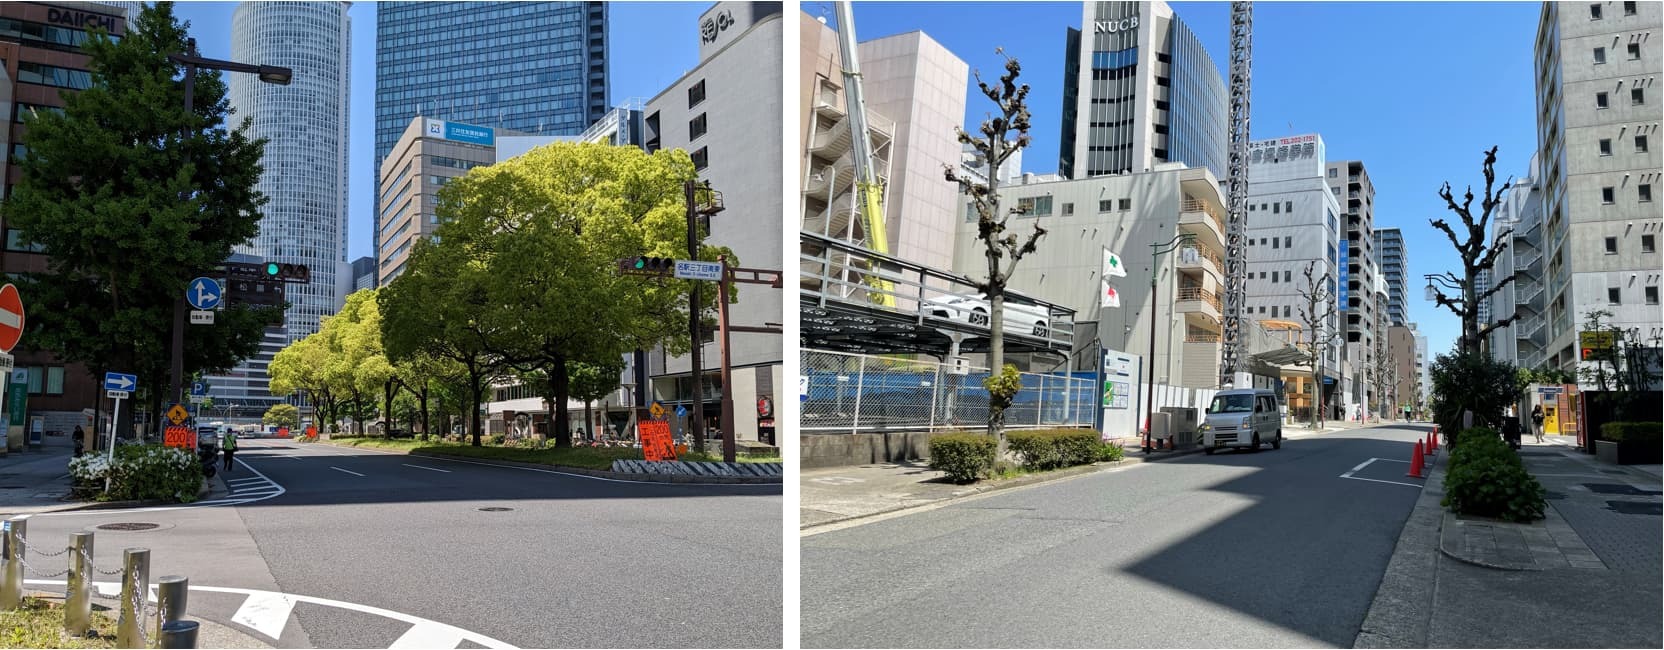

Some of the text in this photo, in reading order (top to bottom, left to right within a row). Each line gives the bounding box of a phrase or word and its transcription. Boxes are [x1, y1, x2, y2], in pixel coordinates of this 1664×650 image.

[48, 8, 115, 32] DAIICHI
[1095, 16, 1139, 33] NUCB
[167, 431, 186, 443] 200
